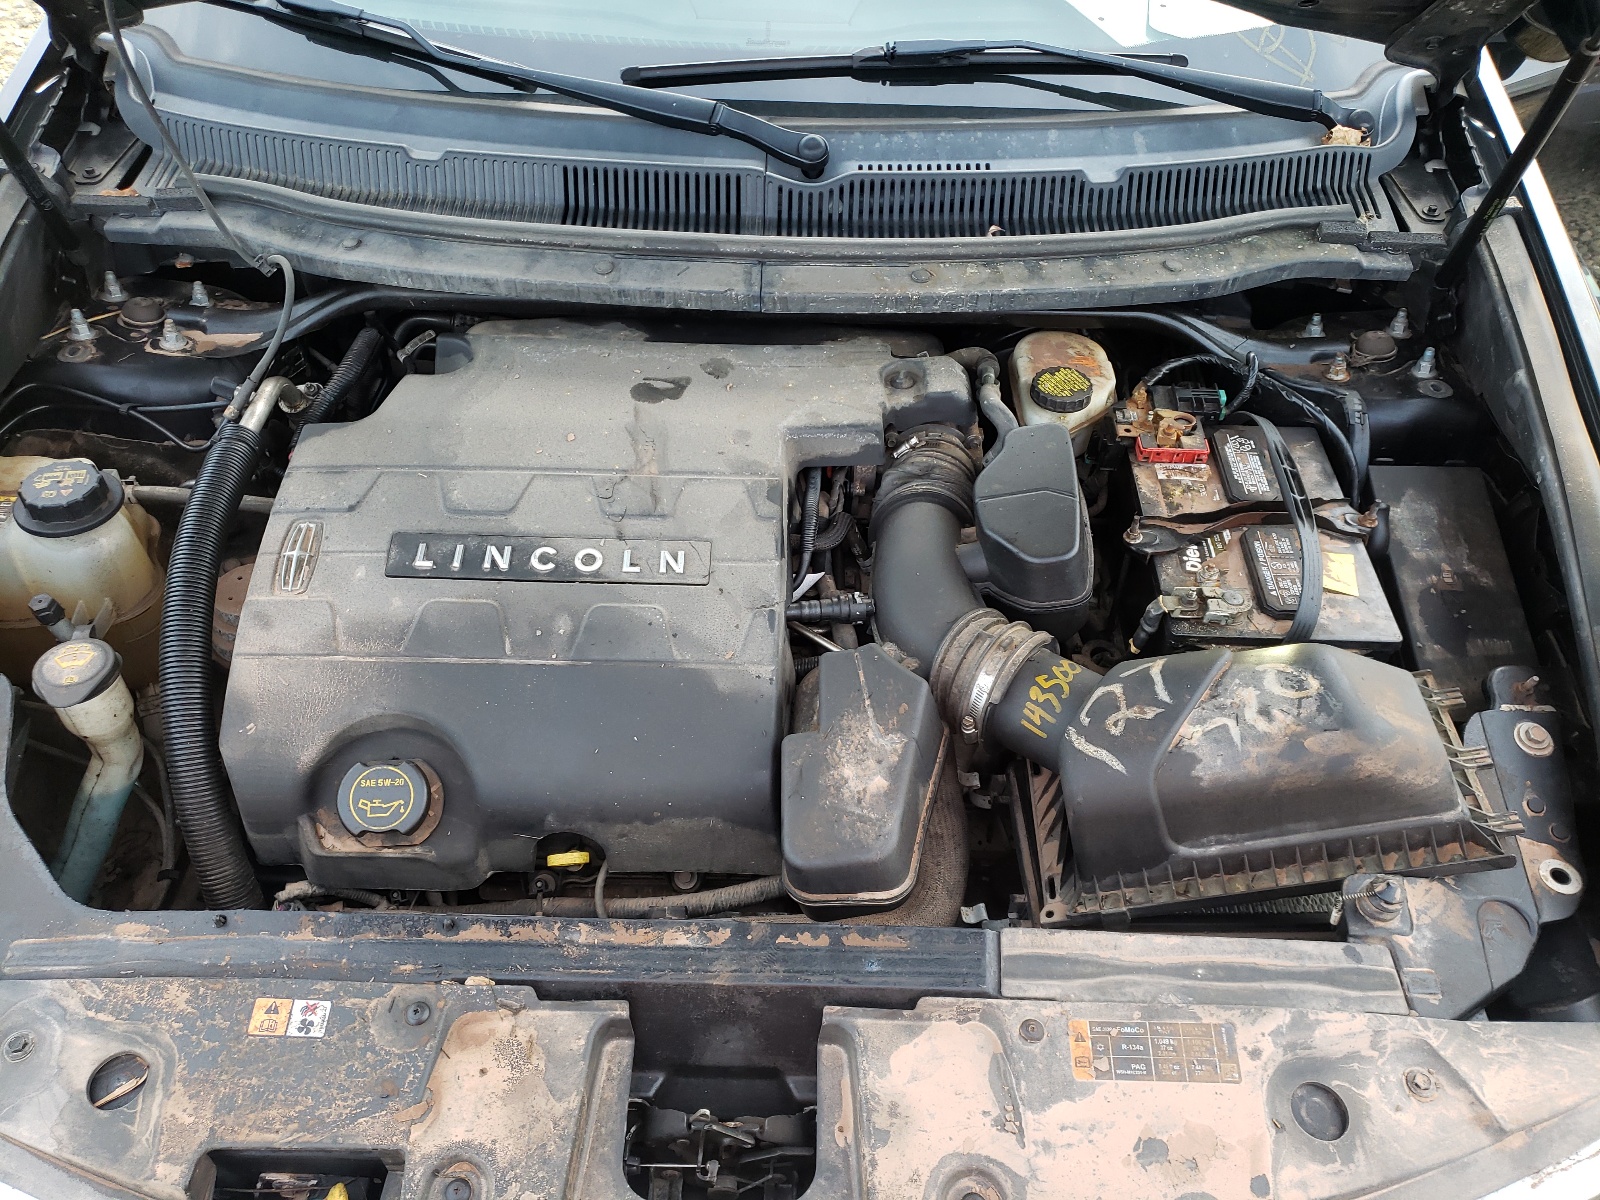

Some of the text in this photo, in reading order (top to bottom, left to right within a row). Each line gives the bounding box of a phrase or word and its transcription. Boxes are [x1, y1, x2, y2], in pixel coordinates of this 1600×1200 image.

[412, 542, 685, 574] LINCOLN
[1020, 658, 1083, 739] 143500
[360, 777, 405, 788] SAE 5W-20
[1116, 1026, 1145, 1034] FoMoCo
[1121, 1043, 1144, 1051] R-134a
